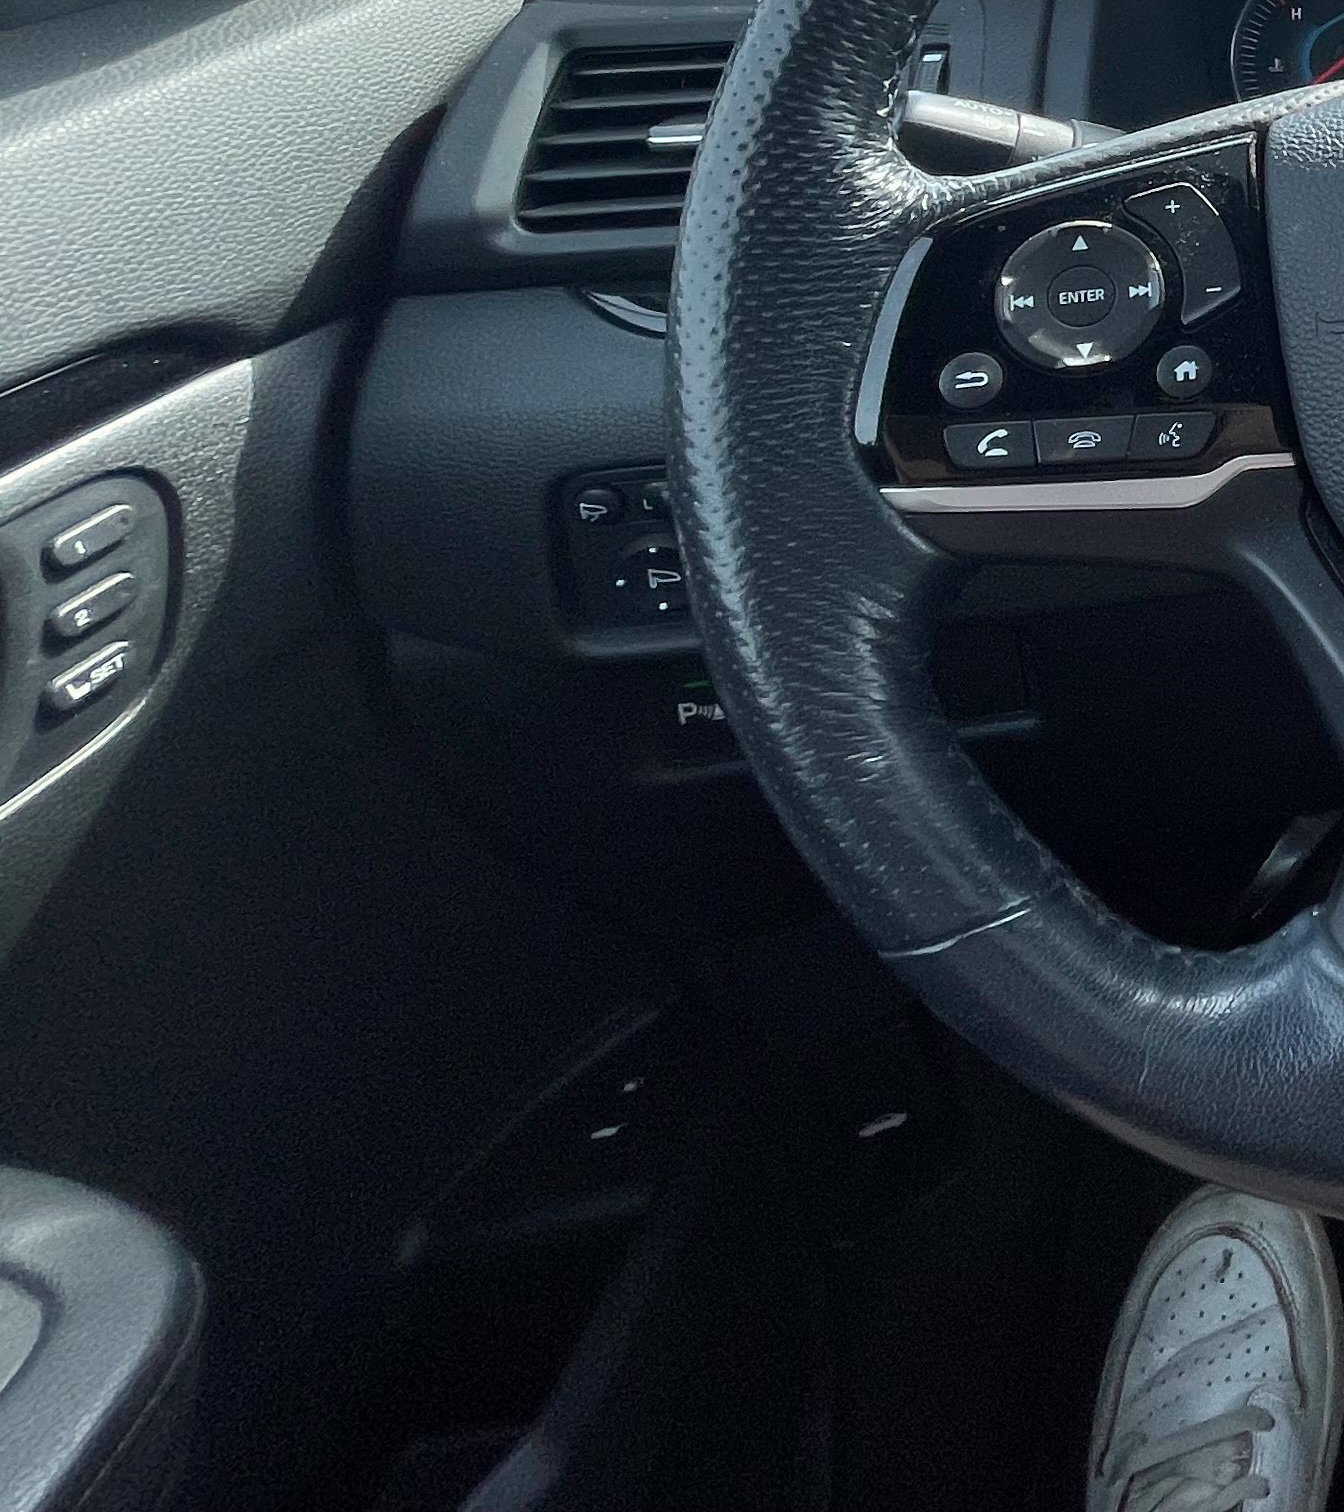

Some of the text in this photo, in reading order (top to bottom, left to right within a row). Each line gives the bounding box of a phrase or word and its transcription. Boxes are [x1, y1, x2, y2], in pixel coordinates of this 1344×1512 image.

[1291, 7, 1302, 20] H
[1059, 288, 1105, 305] ENTER
[74, 540, 87, 555] 1
[74, 608, 92, 627] 2
[89, 652, 127, 684] SET
